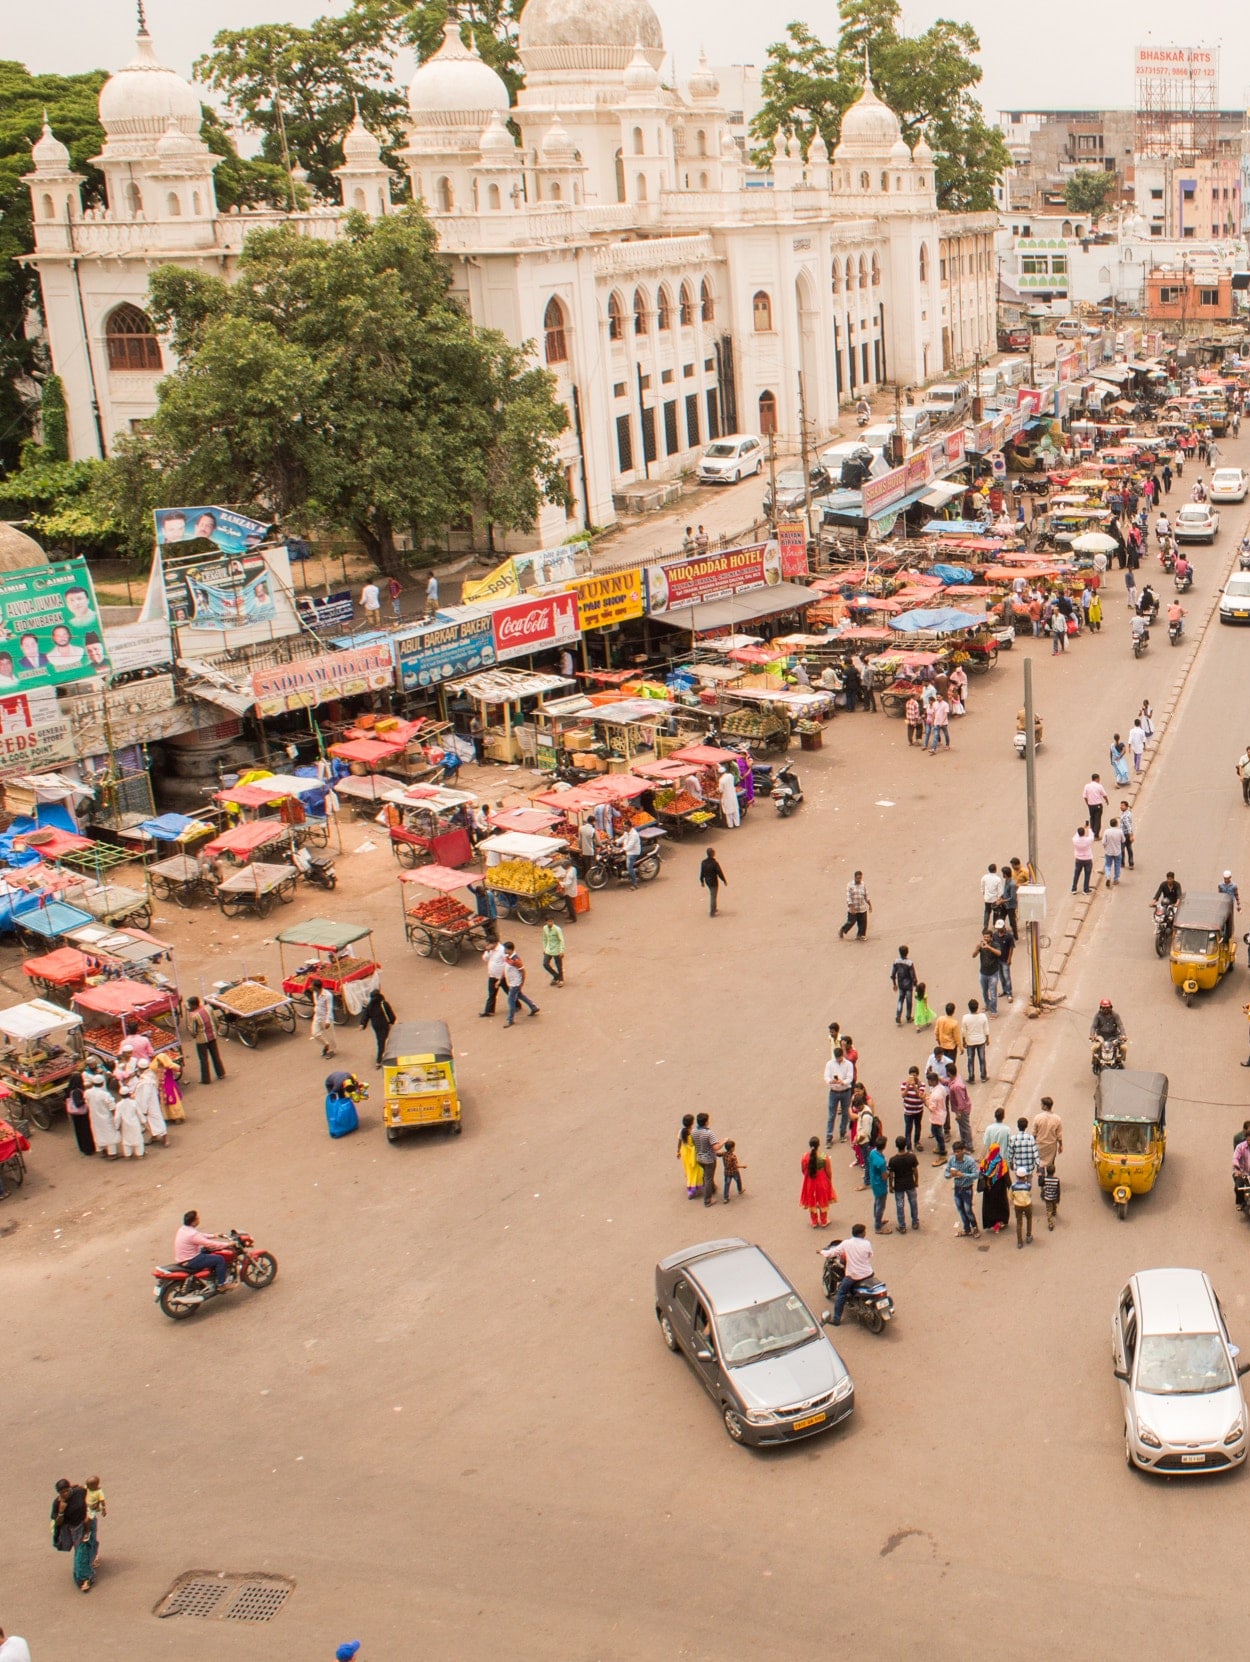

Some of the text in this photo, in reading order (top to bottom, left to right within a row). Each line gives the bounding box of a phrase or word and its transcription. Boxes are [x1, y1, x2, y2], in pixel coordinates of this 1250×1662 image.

[1140, 50, 1184, 62] BHASKAR
[220, 512, 258, 531] RAMZAN
[668, 558, 728, 581] MUQADDAR
[730, 550, 763, 568] HOTEL
[7, 594, 63, 617] ALVIDA JUMMA
[603, 594, 627, 607] SHOP
[29, 613, 64, 628] MUBARAK
[499, 607, 550, 640] Coca-Cola
[400, 616, 491, 654] ABUL BARKAAT BAKERY
[261, 667, 327, 691] SADDAM
[332, 655, 384, 678] HOTEL
[38, 724, 67, 737] GENERAL
[43, 733, 64, 744] STORE
[9, 751, 29, 762] COOL
[31, 745, 53, 757] POINT
